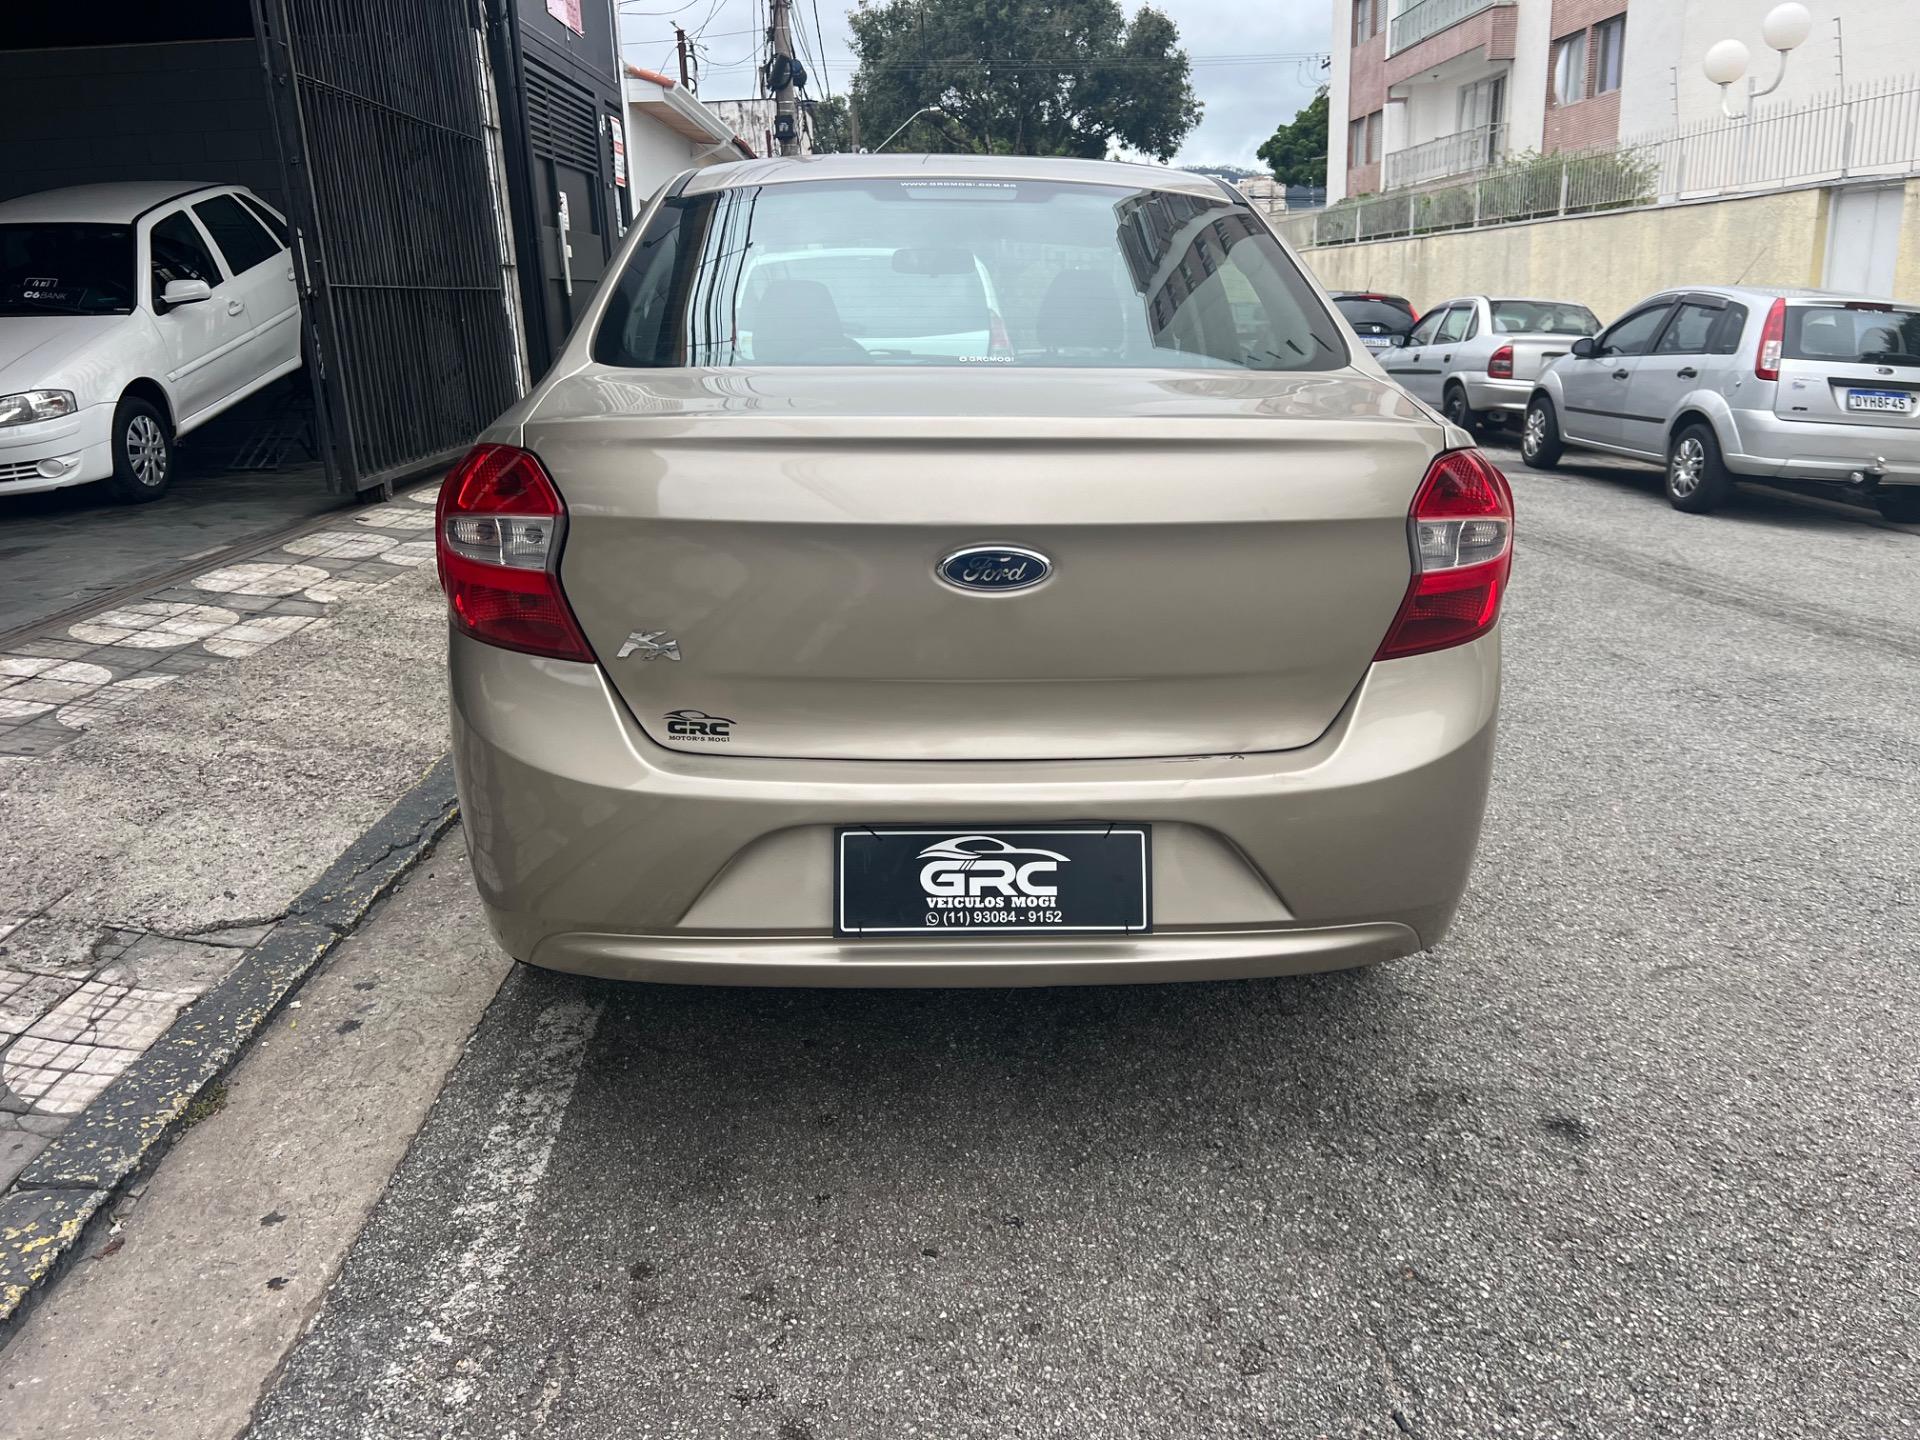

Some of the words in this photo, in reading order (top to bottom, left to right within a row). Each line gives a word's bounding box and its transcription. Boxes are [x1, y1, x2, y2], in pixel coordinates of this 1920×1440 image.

[1855, 395, 1905, 410] DYH8F45
[963, 556, 1027, 582] Ford
[667, 720, 730, 736] GRC
[919, 859, 1058, 897] GRC
[926, 896, 1005, 908] VEICULOS
[1011, 896, 1057, 908] MOGI
[943, 911, 970, 926] (11)
[973, 911, 1017, 923] 93084
[1028, 910, 1062, 923] 9152
